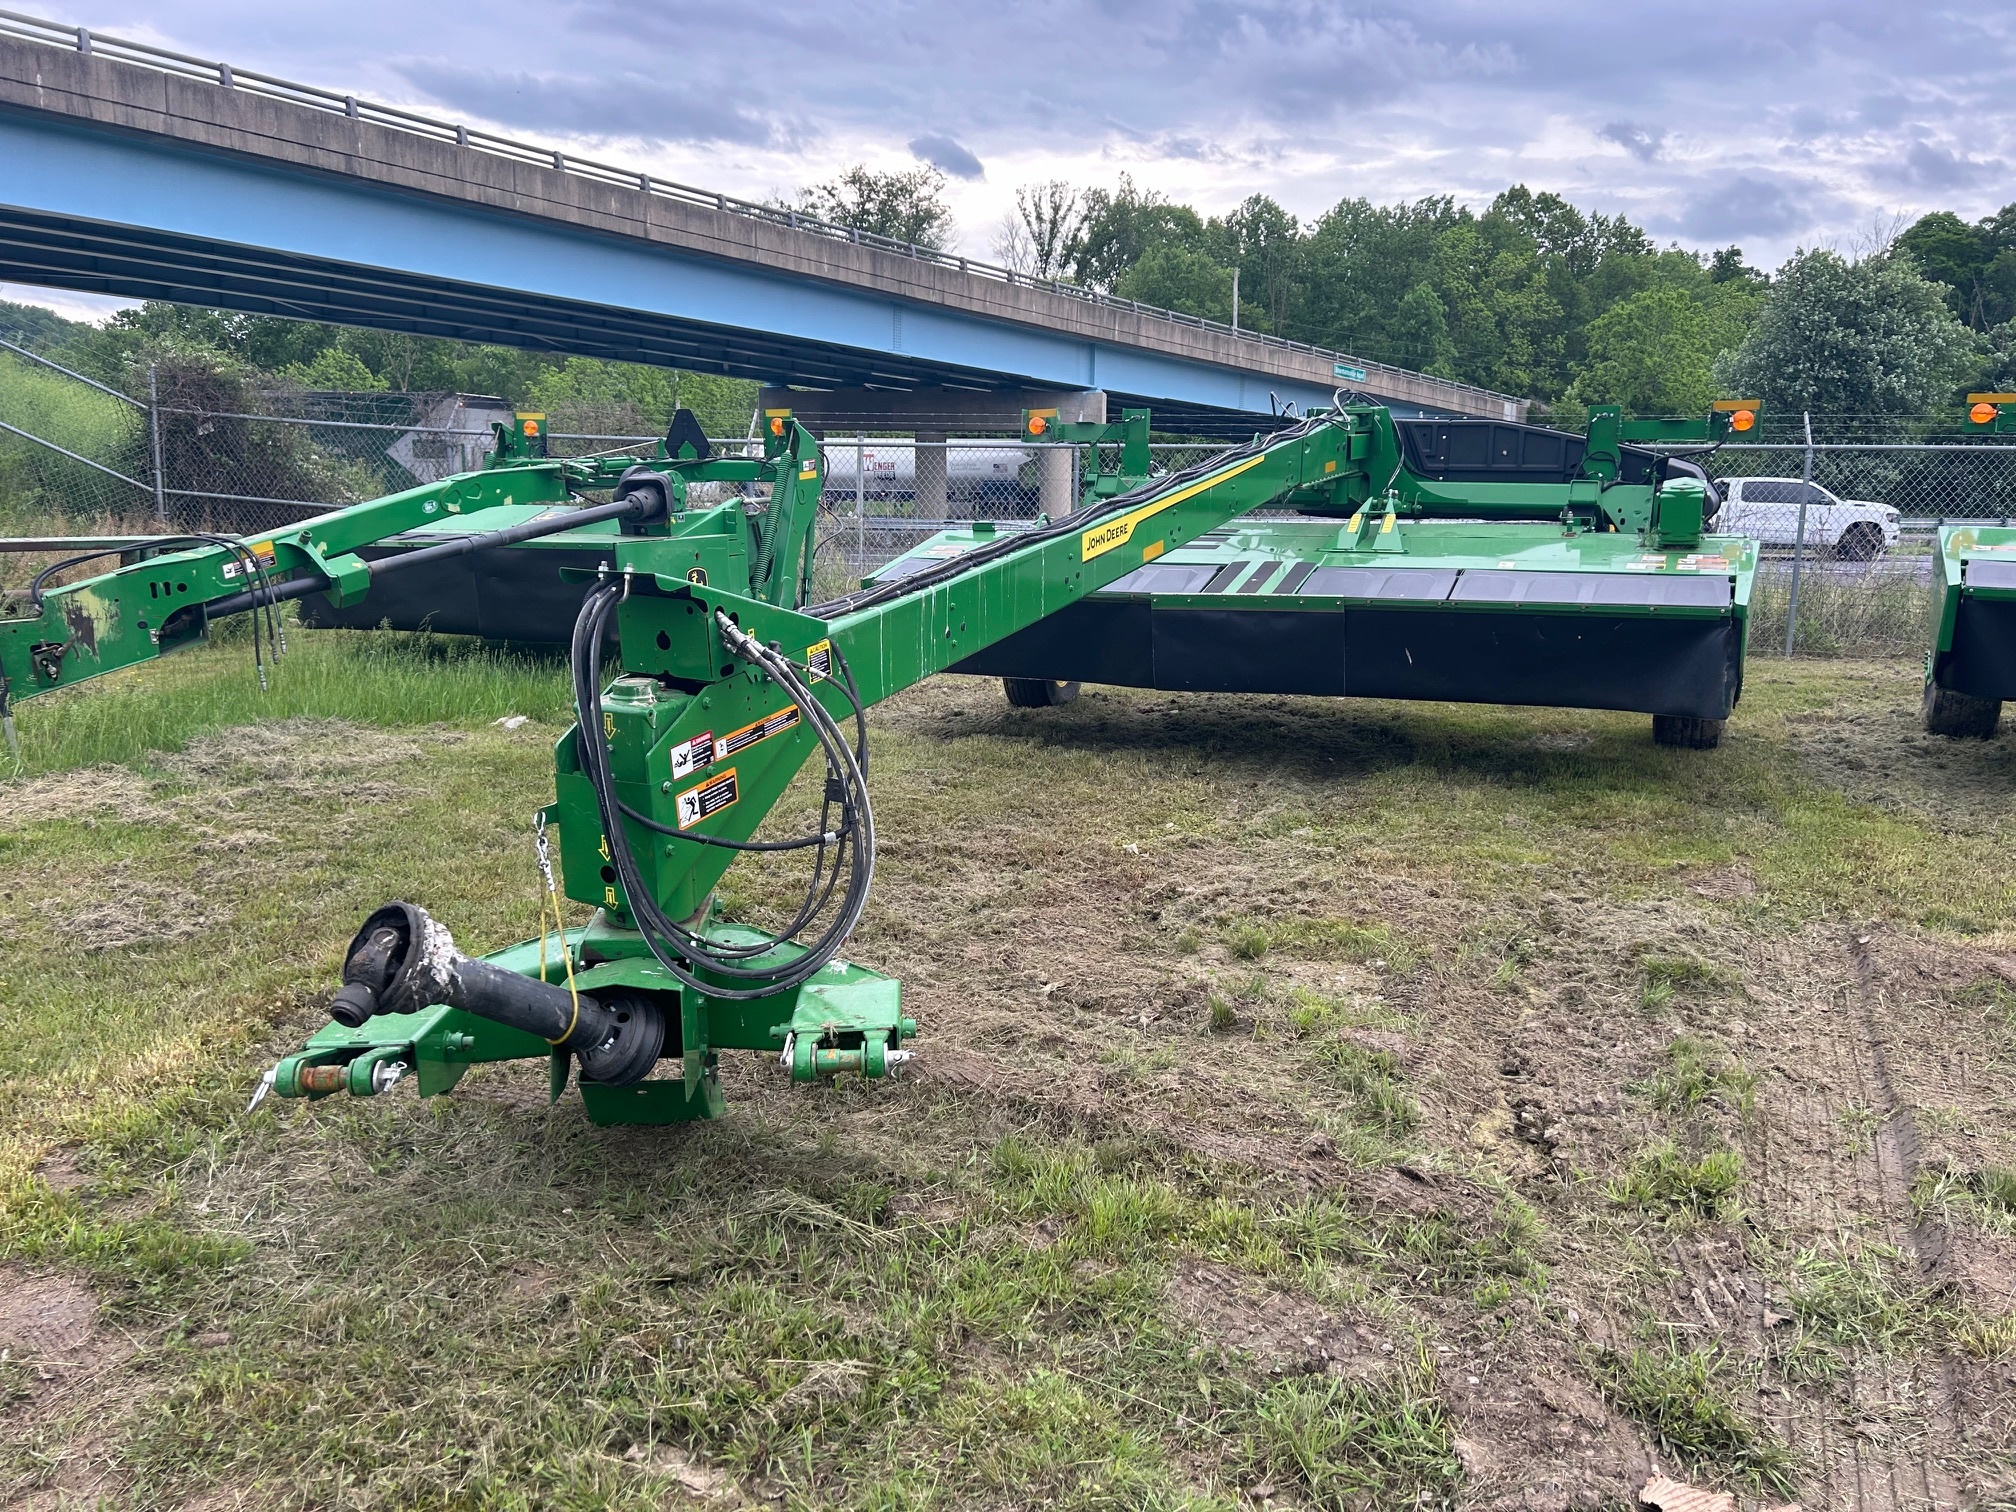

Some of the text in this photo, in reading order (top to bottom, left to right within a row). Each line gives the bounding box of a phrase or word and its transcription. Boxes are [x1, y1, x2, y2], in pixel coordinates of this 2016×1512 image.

[863, 453, 895, 471] WENGER
[1087, 523, 1128, 551] JOHN DEERE
